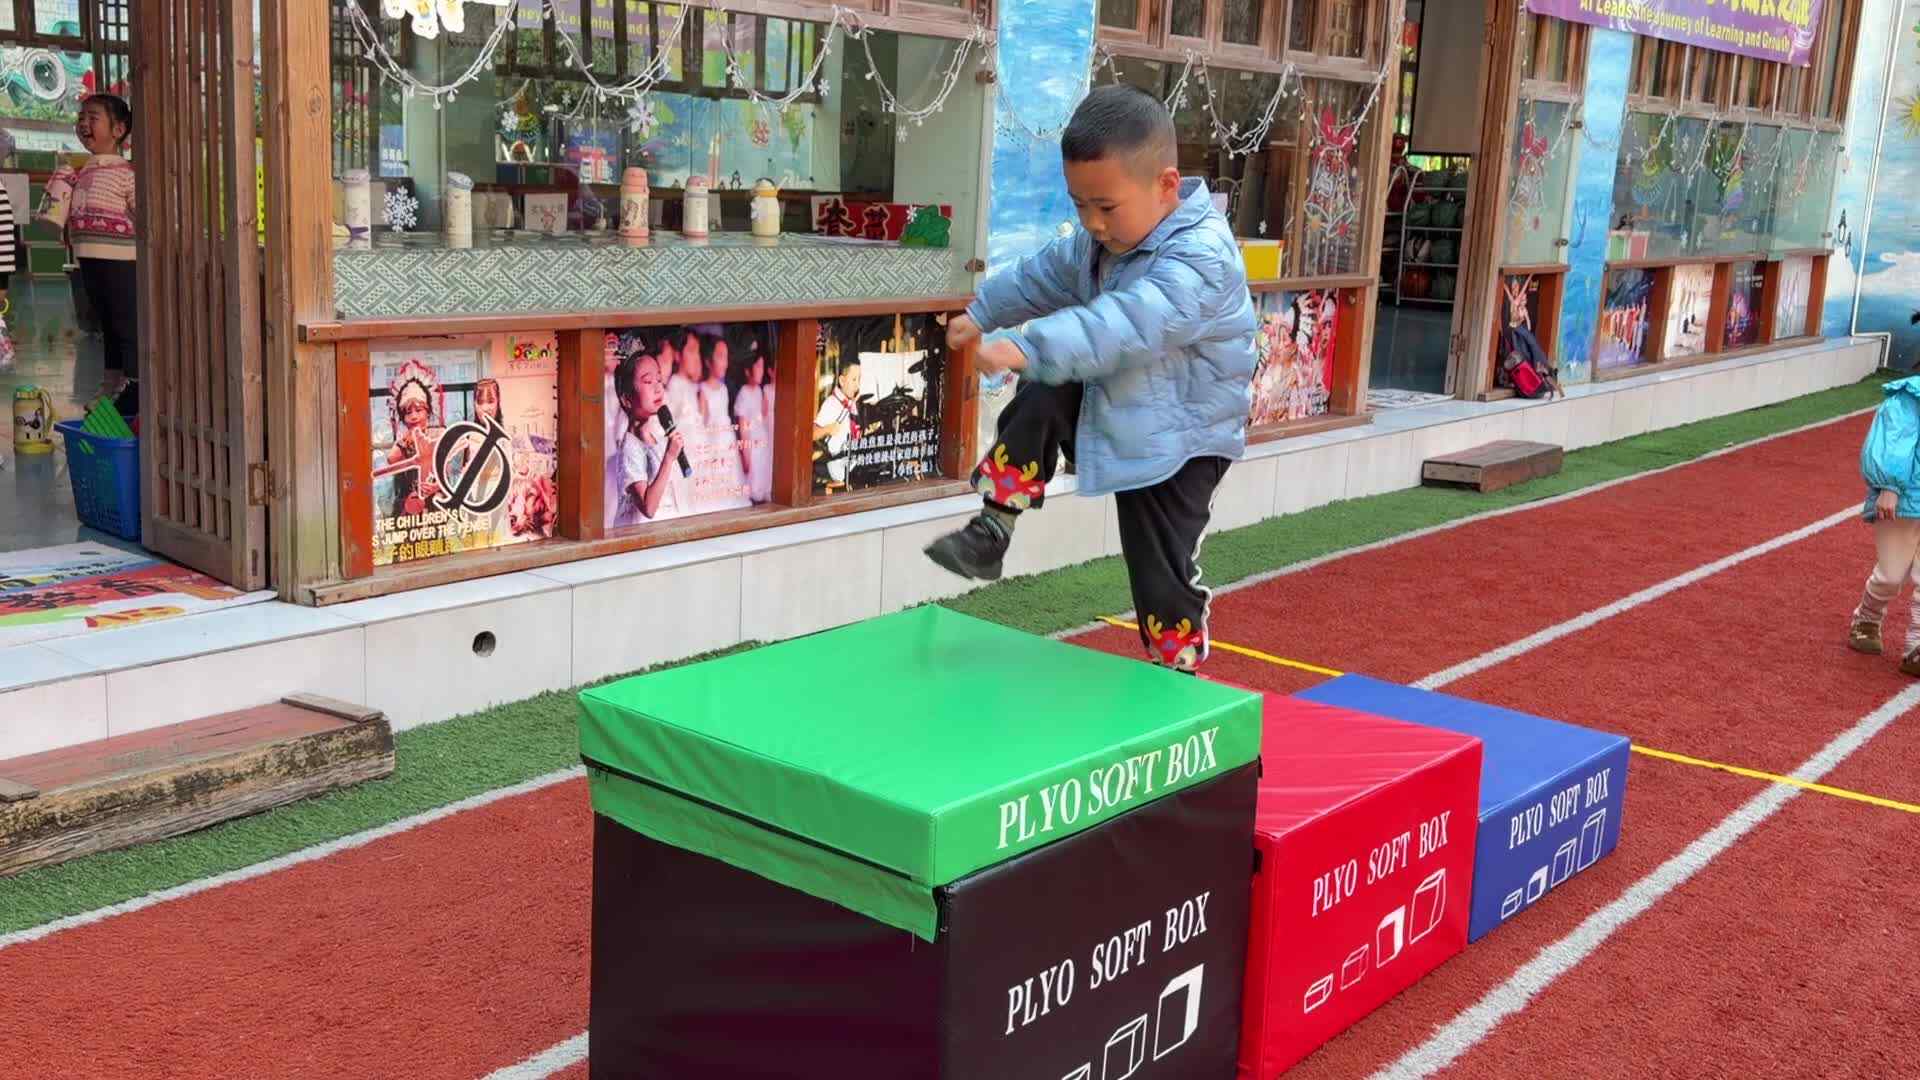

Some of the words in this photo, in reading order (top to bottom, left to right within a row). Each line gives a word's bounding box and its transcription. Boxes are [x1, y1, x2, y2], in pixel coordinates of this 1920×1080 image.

[1596, 0, 1632, 19] Leads
[1654, 11, 1691, 37] Journey
[1695, 16, 1706, 33] of
[1706, 17, 1744, 47] Learning
[1745, 30, 1761, 48] and
[376, 516, 395, 531] THE
[410, 526, 436, 541] OVER
[999, 779, 1081, 848] PLYO
[1088, 751, 1162, 815] SOFT
[1165, 727, 1218, 785] BOX
[1510, 803, 1544, 849] PLYO
[1550, 784, 1580, 826] SOFT
[1586, 768, 1611, 808] BOX
[1312, 860, 1357, 916] PLYO
[1368, 832, 1410, 884] SOFT
[1419, 811, 1450, 858] BOX
[1006, 959, 1074, 1035] PLYO
[1090, 920, 1151, 989] SOFT
[1163, 892, 1210, 952] BOX
